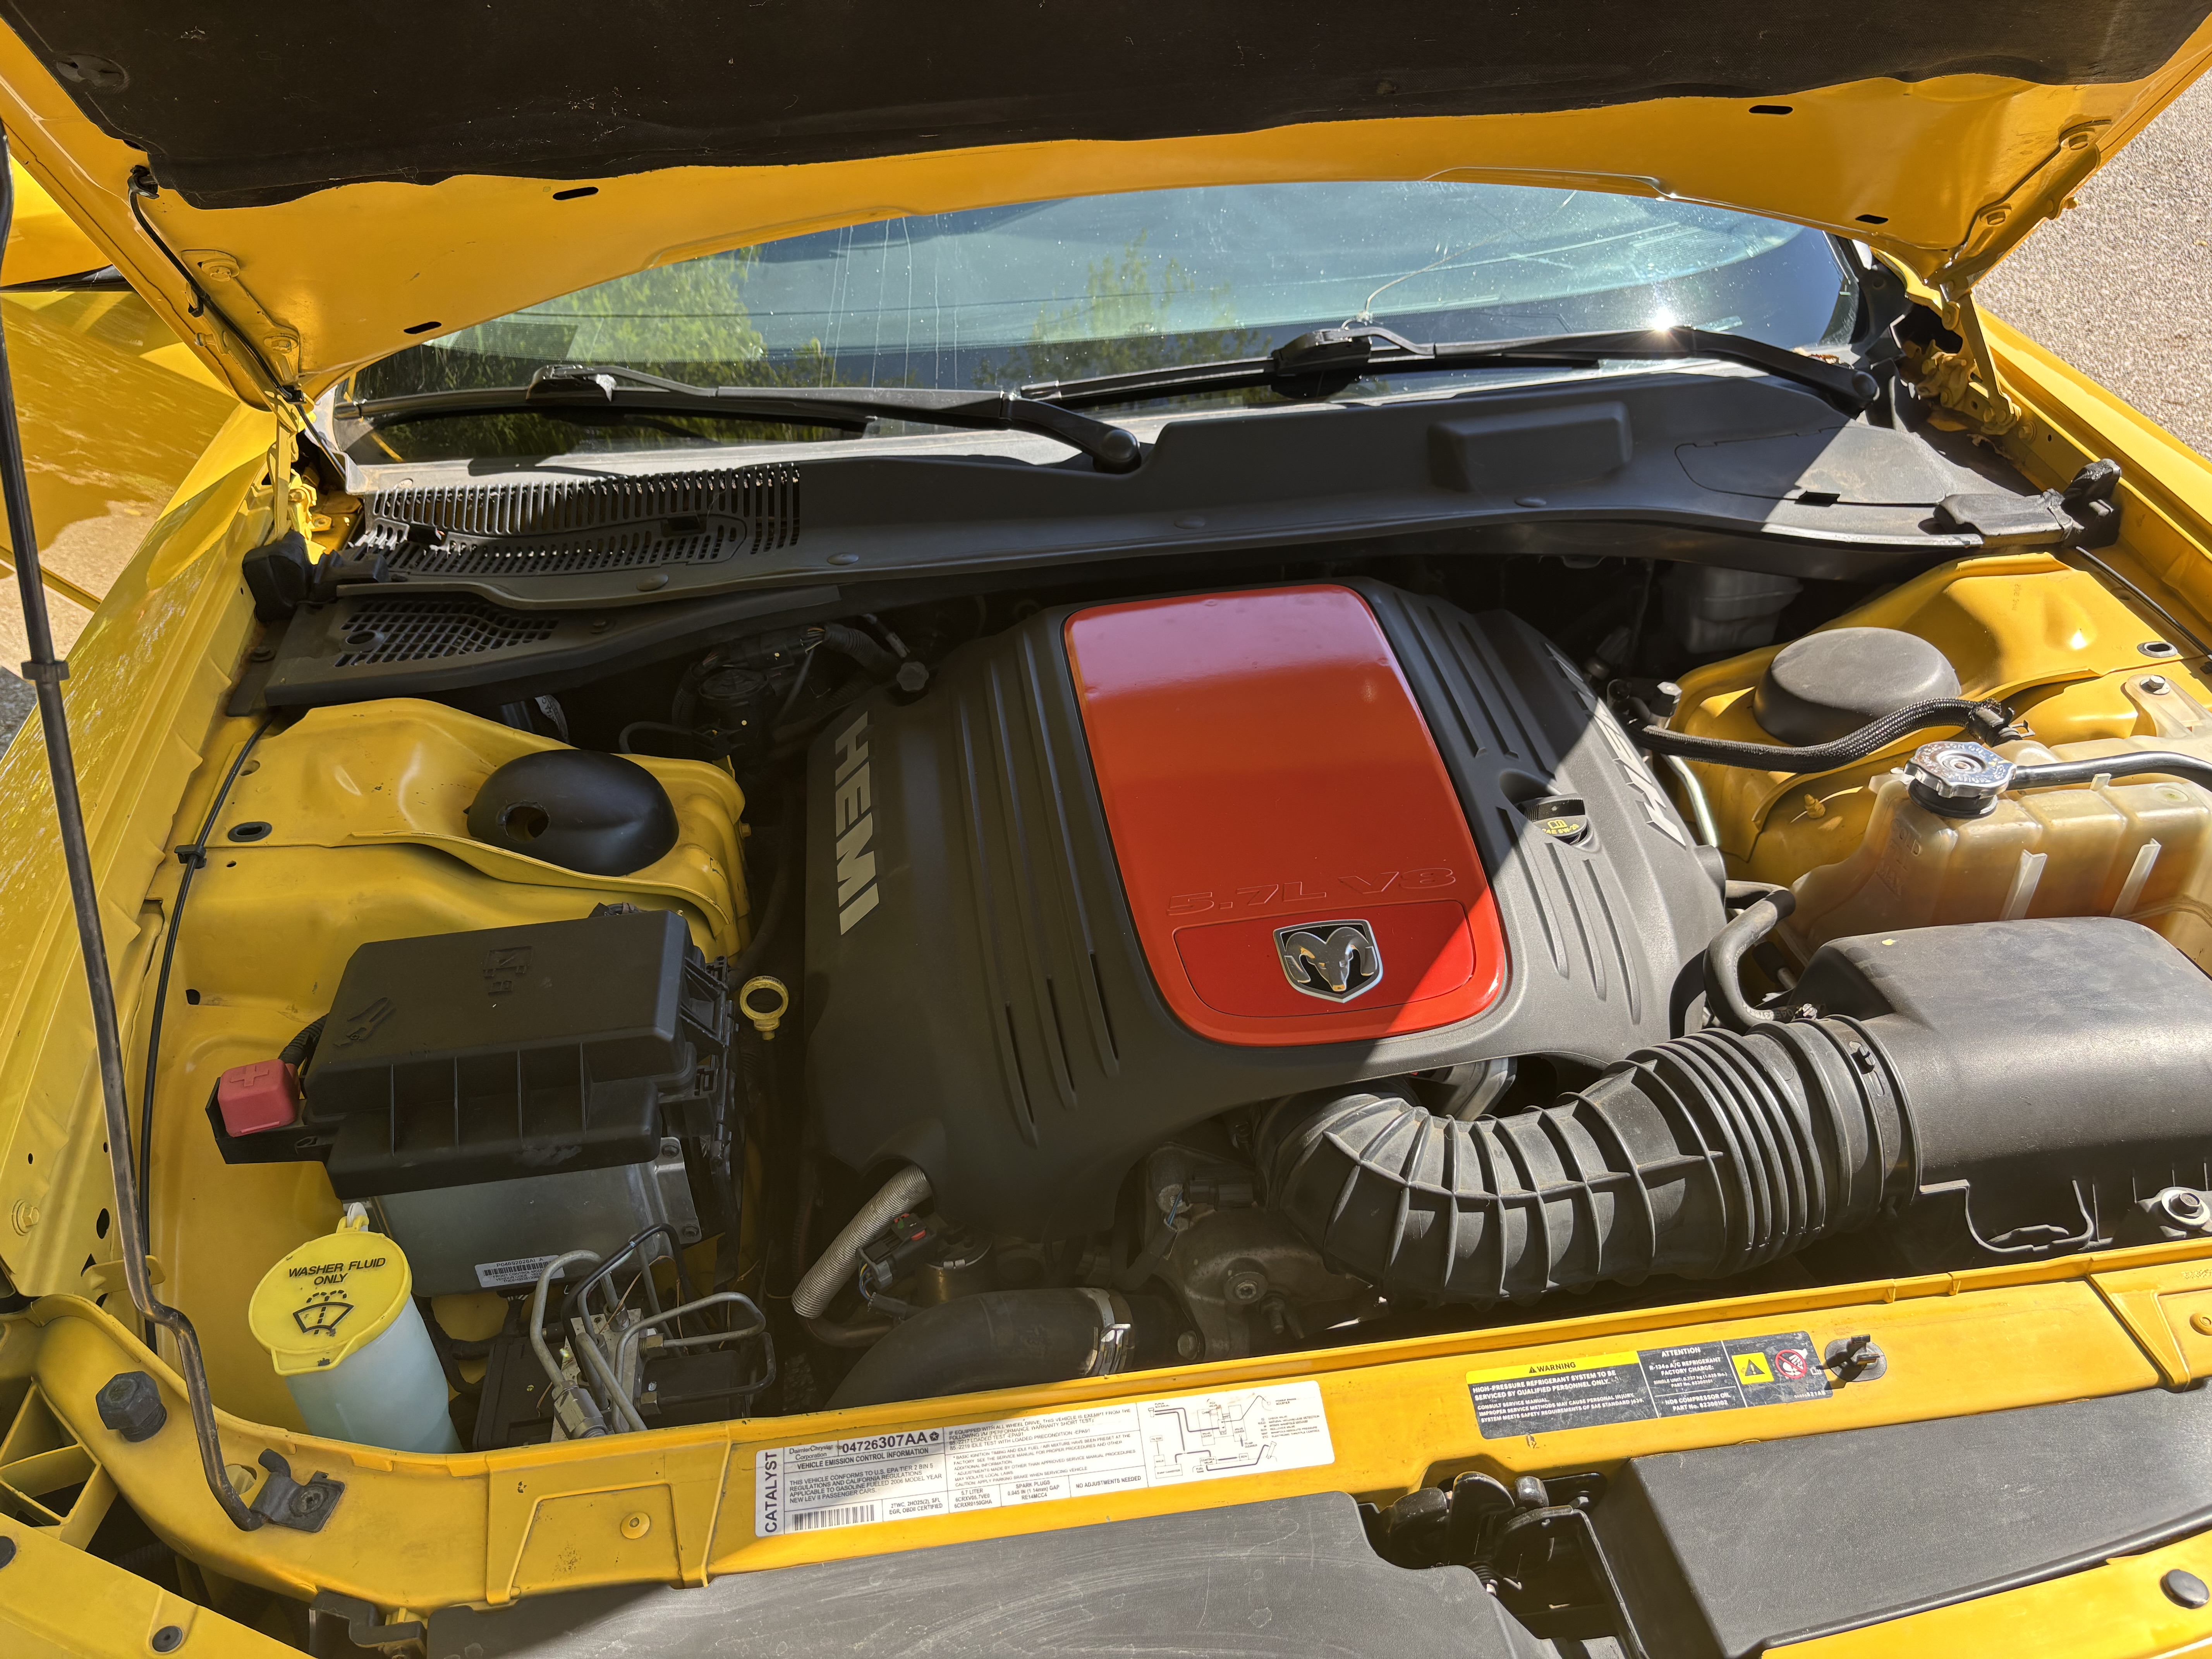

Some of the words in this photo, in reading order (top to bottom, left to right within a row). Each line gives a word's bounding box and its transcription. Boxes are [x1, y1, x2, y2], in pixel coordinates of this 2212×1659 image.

[835, 711, 879, 936] HEMI
[1166, 881, 1326, 915] 5.7L
[1337, 867, 1456, 895] V8
[289, 1263, 344, 1278] WASHER
[349, 1257, 386, 1271] FLUID
[314, 1273, 349, 1286] ONLY
[1659, 1346, 1702, 1357] ATTENTION
[1536, 1361, 1577, 1372] WARNING
[1681, 1356, 1722, 1367] REFRIGERANT
[1660, 1368, 1688, 1376] FACTORY
[1687, 1364, 1715, 1372] CHARGE:
[1472, 1381, 1525, 1394] HIGH-PRESSURE
[1525, 1376, 1571, 1387] REFRIGERANT
[1570, 1372, 1597, 1381] SYSTEM
[1474, 1391, 1507, 1401] SERVICED
[1516, 1386, 1552, 1396] QUALIFIED
[1551, 1381, 1591, 1391] PERSONNEL
[1590, 1378, 1611, 1386] ONLY.
[1678, 1393, 1720, 1404] COMPRESSOR
[1478, 1408, 1506, 1417] IMPROPER
[1540, 1406, 1582, 1415] REQUIREMENTS
[1601, 1400, 1630, 1408] STANDARD
[949, 1432, 979, 1441] FOLLOWING
[955, 1427, 981, 1435] EQUIPPED
[1034, 1431, 1072, 1440] PRECONDITION
[842, 1431, 928, 1453] 04726307AA
[795, 1451, 827, 1461] Corporation
[797, 1460, 823, 1470] VEHICLE
[825, 1456, 854, 1467] EMISSION
[856, 1452, 884, 1463] CONTROL
[887, 1447, 929, 1459] INFORMATION
[789, 1481, 830, 1492] REGULATIONS
[846, 1475, 880, 1485] CALIFORNIA
[881, 1470, 923, 1480] REGULATIONS
[804, 1476, 828, 1484] VEHICLE
[830, 1472, 863, 1481] CONFORMS
[1084, 1478, 1120, 1487] ADJUSTMENTS
[764, 1451, 778, 1533] CATALYST
[789, 1488, 824, 1498] APPLICABLE
[836, 1483, 865, 1492] GASOLINE
[866, 1480, 889, 1488] FUELED
[905, 1475, 924, 1483] MODEL
[822, 1490, 857, 1499] PASSENGER
[917, 1503, 943, 1511] CERTIFIED
